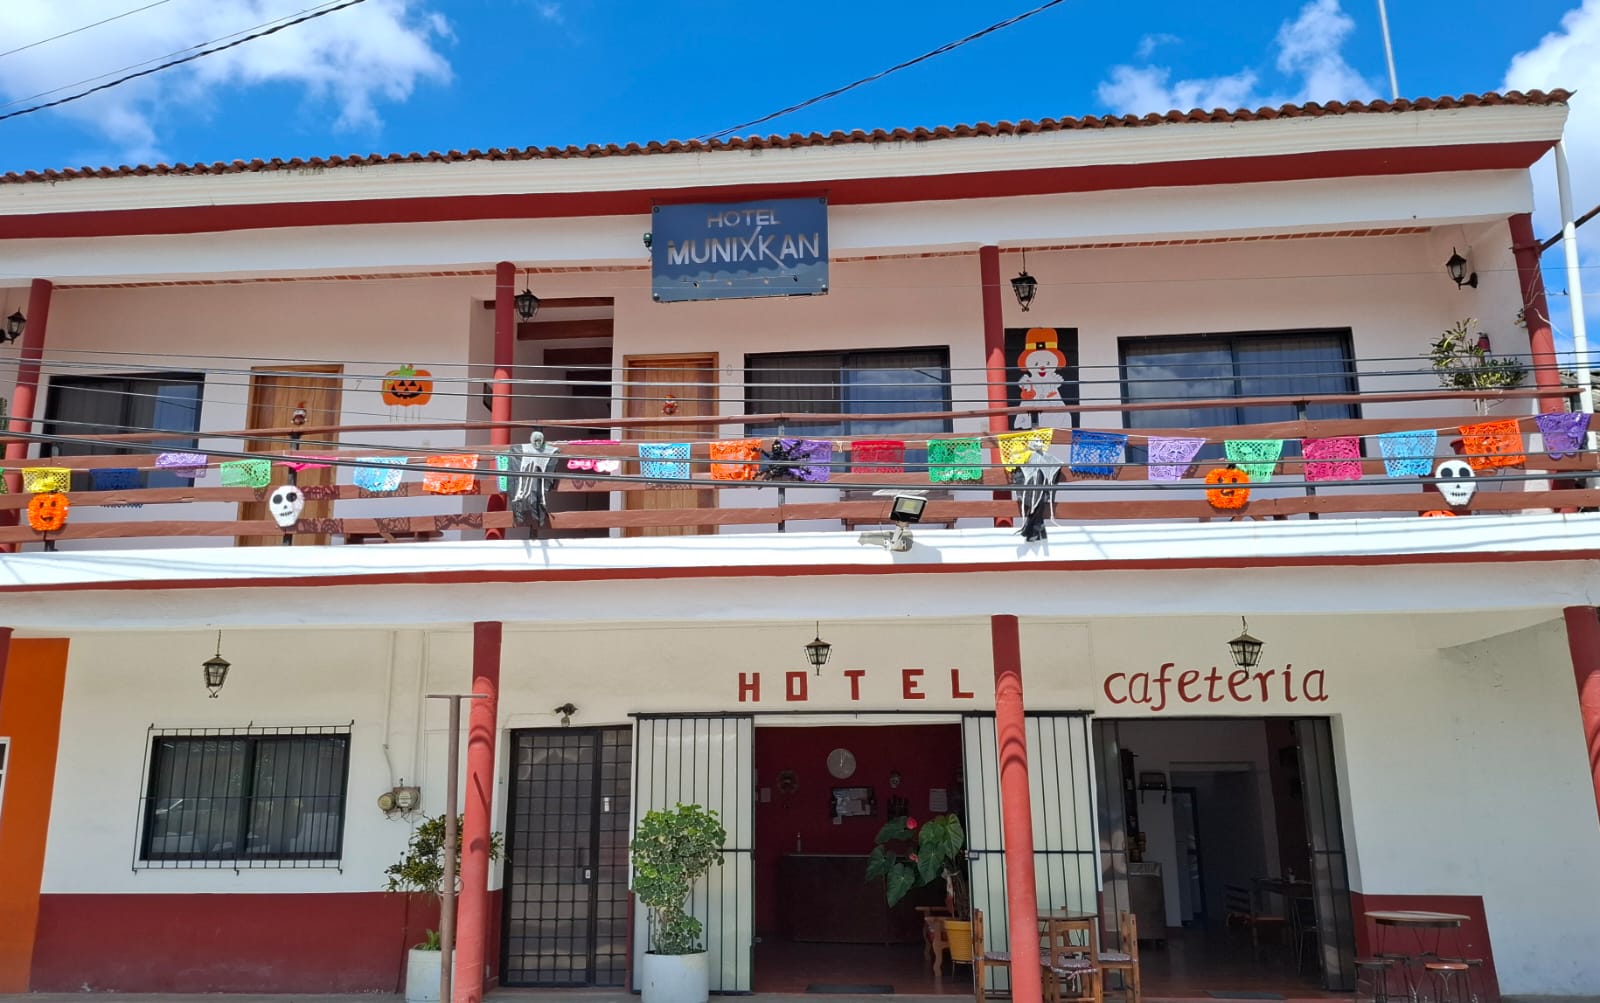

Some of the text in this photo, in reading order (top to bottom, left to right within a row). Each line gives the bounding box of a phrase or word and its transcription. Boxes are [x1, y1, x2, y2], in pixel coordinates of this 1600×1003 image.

[707, 209, 781, 228] HOTEL
[667, 226, 819, 268] MUNIXKAN
[738, 668, 974, 702] HOTEL
[1103, 663, 1329, 711] cafeteria
